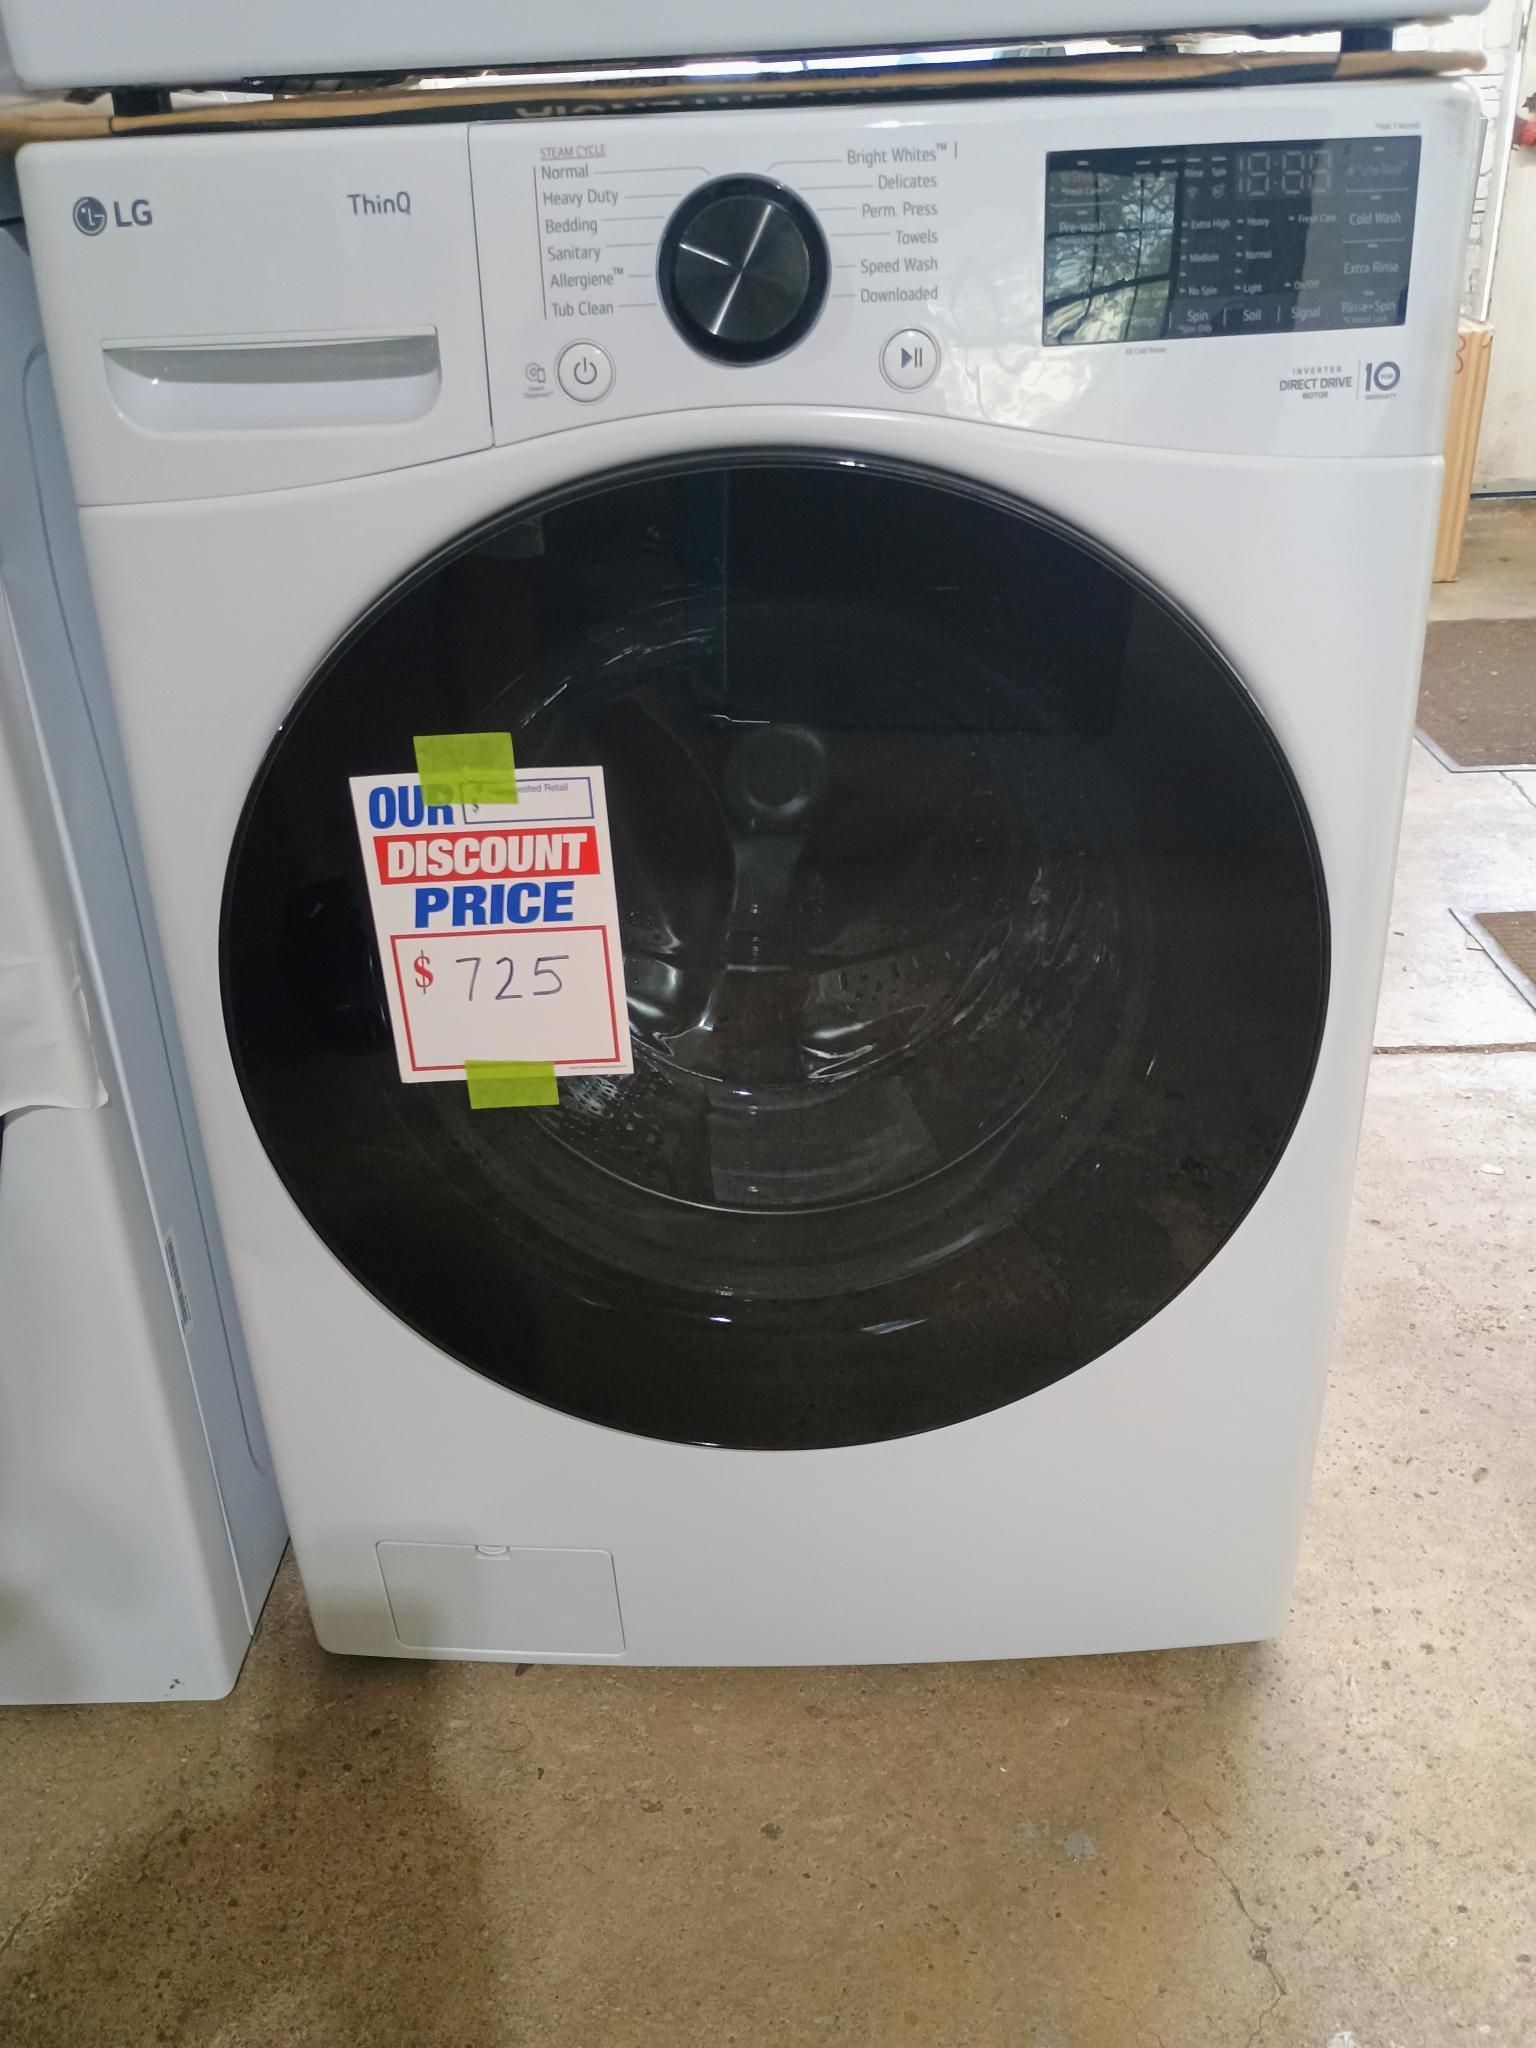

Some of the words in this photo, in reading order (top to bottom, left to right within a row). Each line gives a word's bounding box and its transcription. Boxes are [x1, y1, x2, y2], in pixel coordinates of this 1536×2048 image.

[540, 147, 573, 159] STEAM
[577, 144, 606, 158] CYCLE
[847, 148, 887, 168] Bright
[541, 163, 589, 180] Normal
[878, 174, 937, 190] Delicates
[347, 191, 411, 215] ThinQ
[543, 191, 583, 208] Heavy
[587, 188, 618, 206] Duty
[113, 199, 153, 228] LG
[862, 203, 898, 218] Perm.
[903, 201, 938, 216] Press
[545, 216, 598, 236] Bedding
[1349, 213, 1373, 226] Cold
[1375, 211, 1401, 224] Wash
[896, 228, 938, 245] Towels
[547, 244, 601, 263] Sanitary
[861, 258, 900, 277] Speed
[904, 256, 938, 272] Wash
[1343, 262, 1370, 274] Extra
[1372, 261, 1399, 273] Rinse
[861, 285, 938, 303] Downloaded
[552, 302, 574, 317] Tub
[578, 301, 614, 316] Clean
[1187, 310, 1209, 323] Spin
[1243, 309, 1262, 322] Soil
[1291, 307, 1321, 322] Signal
[1292, 365, 1342, 375] INVERTER
[1365, 361, 1400, 392] 10
[1279, 378, 1317, 391] DIRECT
[1320, 376, 1352, 389] DRIVE
[1302, 391, 1328, 399] MOTOR
[544, 782, 568, 792] Retail
[369, 785, 454, 829] OUR
[387, 832, 588, 878] DISCOUNT
[414, 881, 575, 928] PRICE
[413, 949, 434, 994] $
[455, 955, 569, 1001] 725
